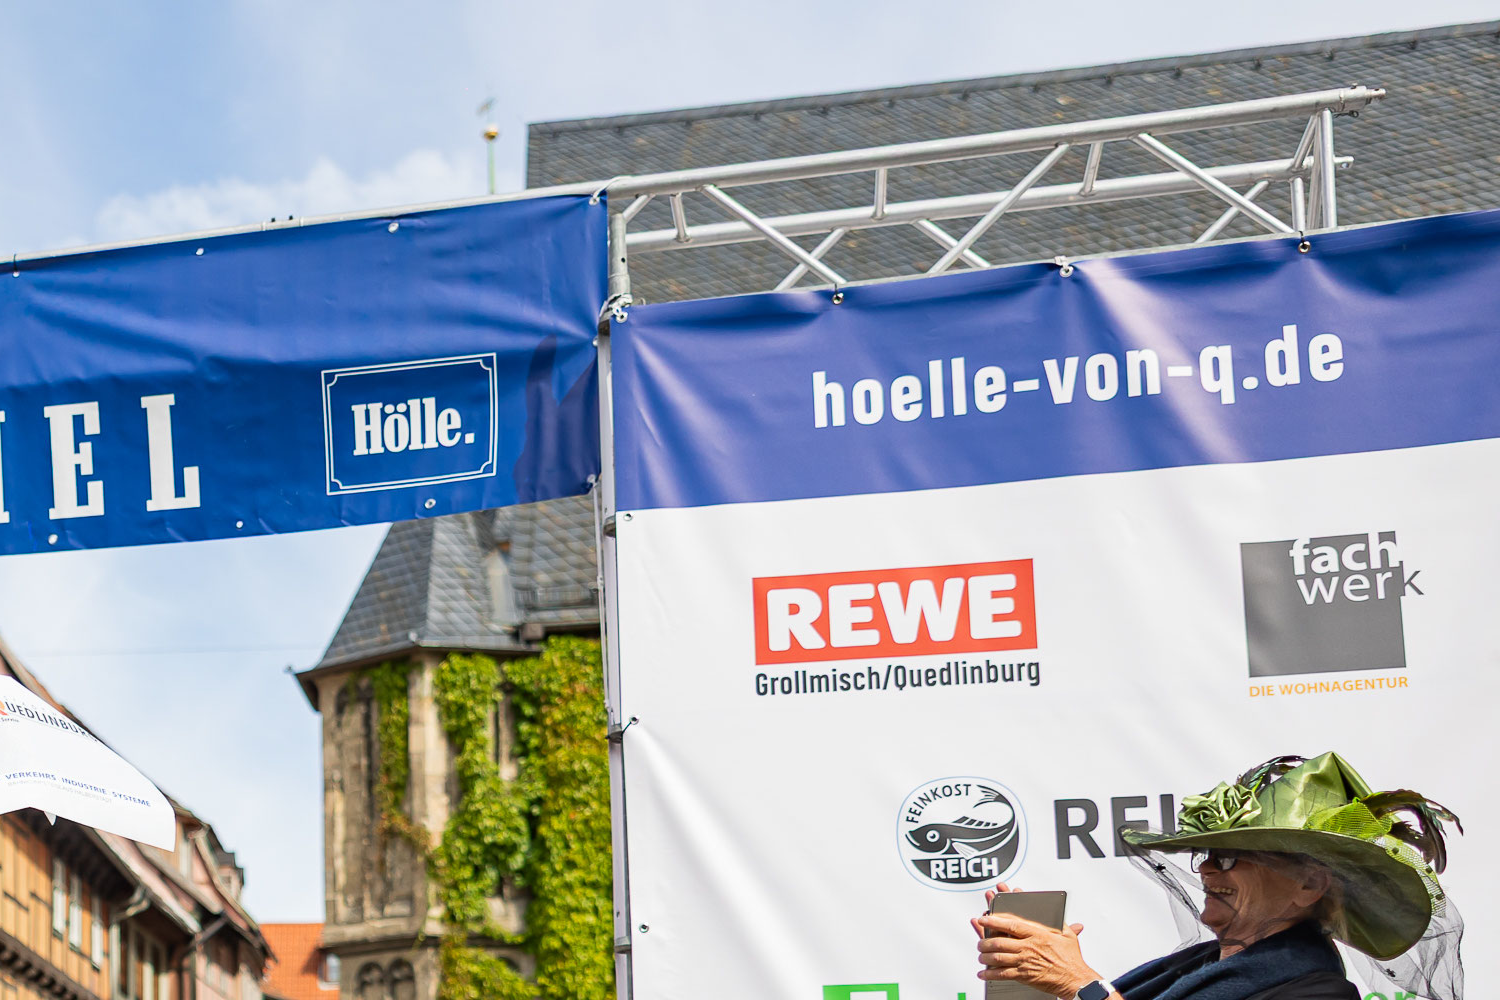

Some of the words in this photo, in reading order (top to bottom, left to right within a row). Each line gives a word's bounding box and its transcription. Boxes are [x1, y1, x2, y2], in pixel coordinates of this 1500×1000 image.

[812, 324, 1345, 429] hoelle-von-q.de
[351, 398, 474, 457] Hölle.
[1289, 533, 1399, 577] fach
[1297, 561, 1425, 605] werk
[765, 573, 1023, 653] REWE
[754, 658, 1041, 697] Grollmisch/Quedlinburg
[1248, 685, 1275, 698] DIE
[1278, 675, 1410, 697] WOHNAGENTUR
[5, 771, 57, 781] VERKEHRS
[61, 777, 107, 795] INDUSTRIE
[112, 791, 151, 807] SYSTEME
[905, 783, 972, 824] FEINKOST
[1053, 793, 1178, 860] REI
[929, 857, 999, 880] REICH
